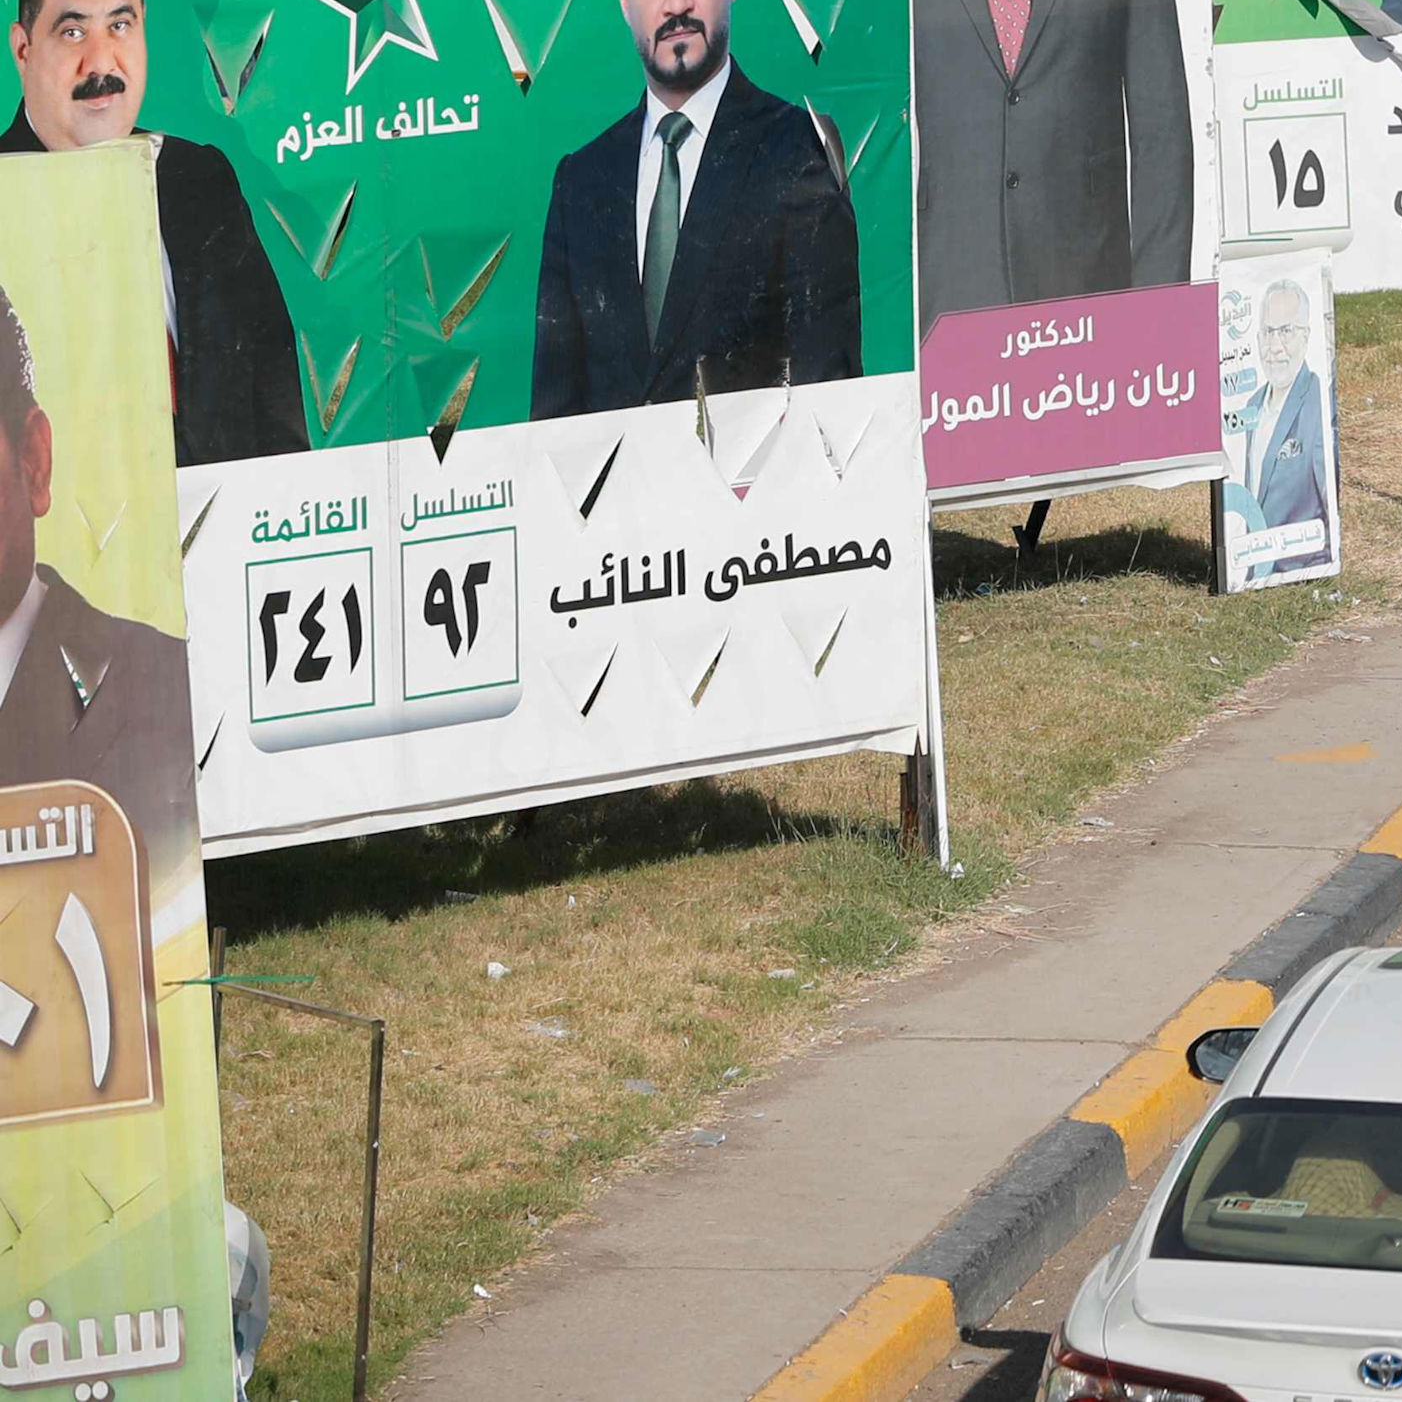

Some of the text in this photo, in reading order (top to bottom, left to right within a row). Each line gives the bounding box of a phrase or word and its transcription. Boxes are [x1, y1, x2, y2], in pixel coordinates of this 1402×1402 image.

[1243, 78, 1343, 111] التسلسل
[276, 94, 480, 164] تحالف العزم
[1268, 138, 1325, 210] ١٥
[1000, 315, 1094, 359] الدكتور
[1022, 372, 1115, 421] رياض
[1126, 362, 1196, 407] ريان
[251, 495, 368, 544] القائمة
[400, 479, 514, 532] التسلسل
[549, 532, 892, 629] مصطفى النائب
[259, 582, 363, 688] ٢٤١
[423, 560, 492, 659] ٩٢
